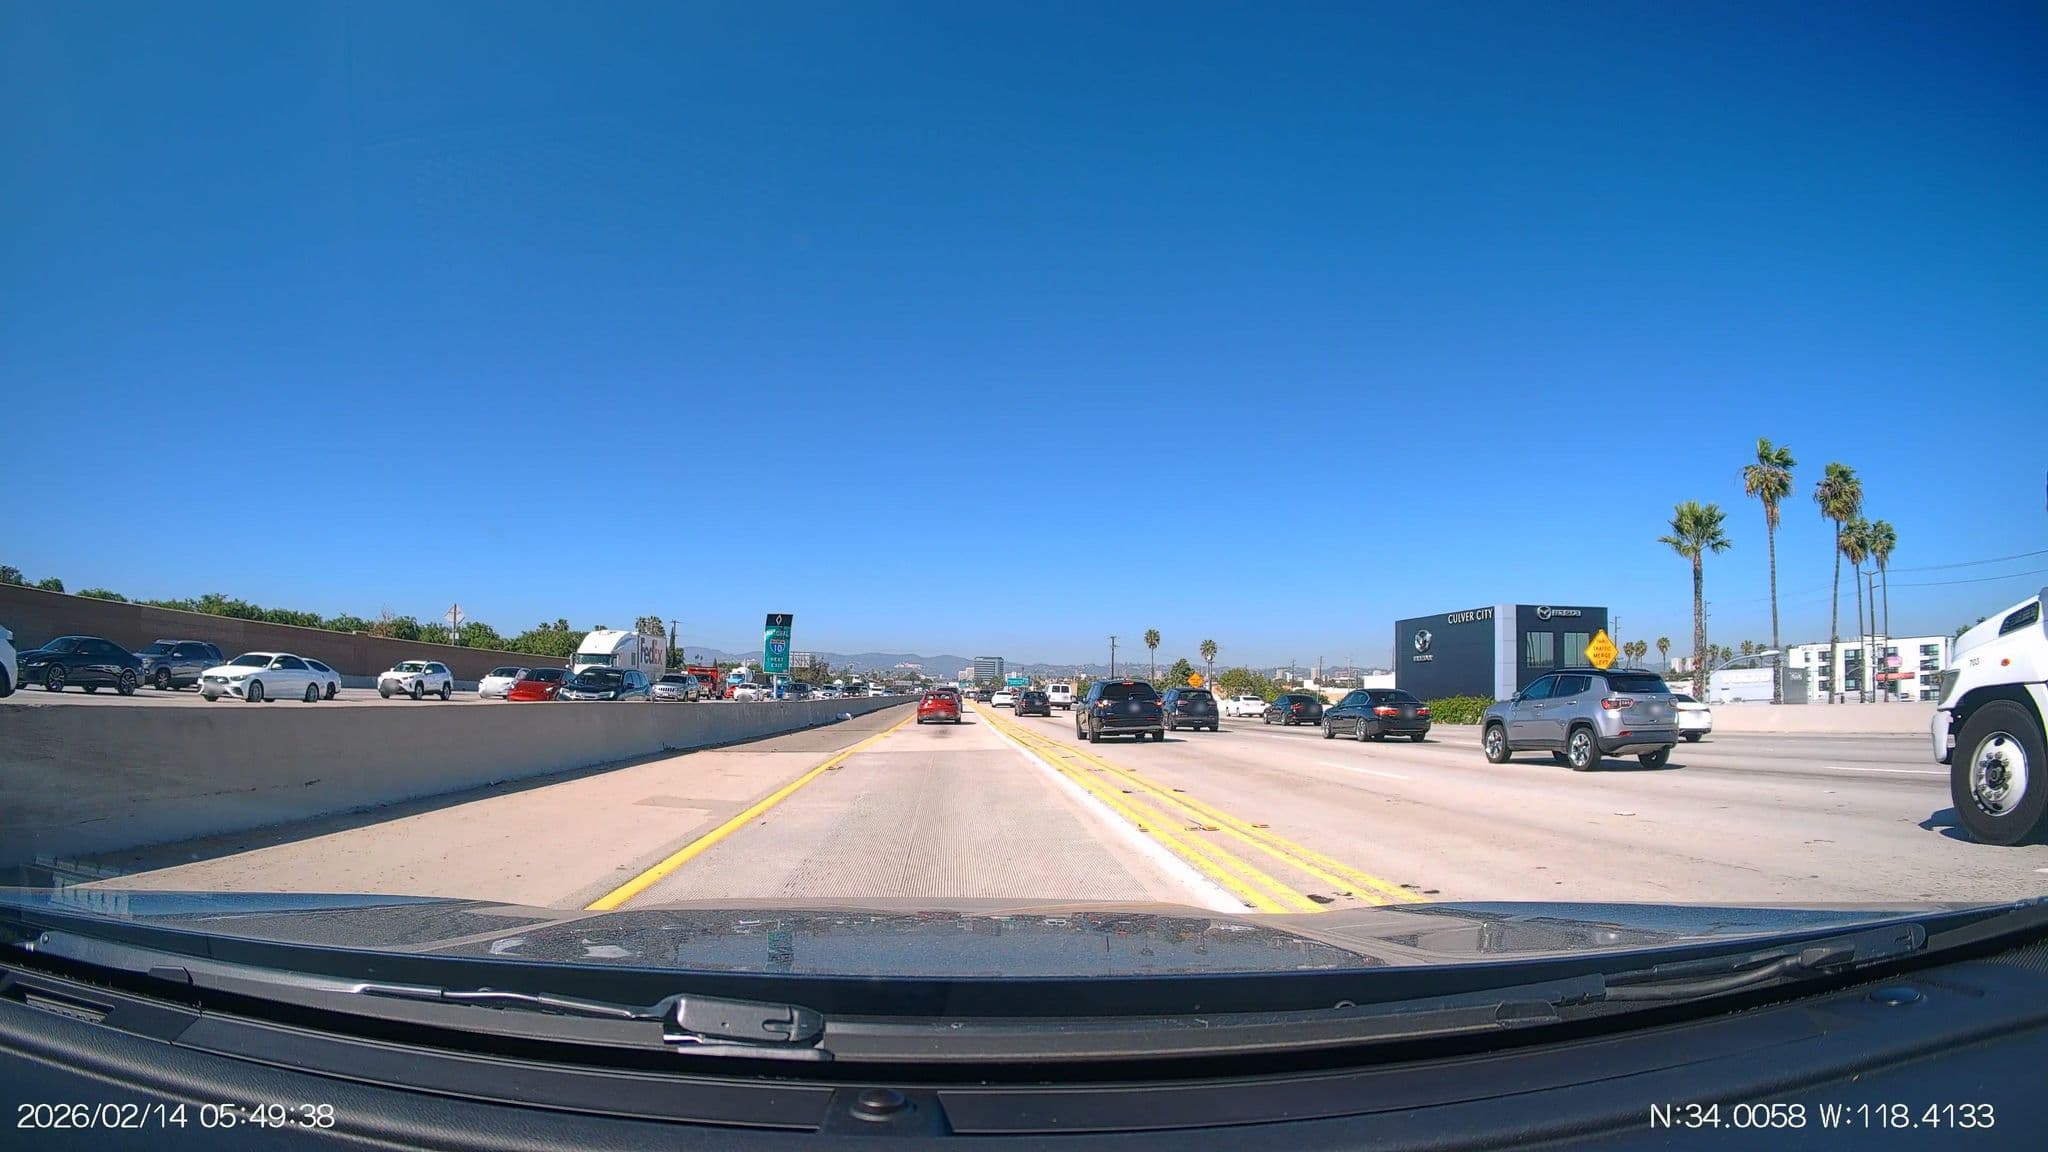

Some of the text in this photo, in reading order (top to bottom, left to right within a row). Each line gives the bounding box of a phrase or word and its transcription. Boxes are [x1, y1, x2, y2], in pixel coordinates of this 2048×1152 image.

[1447, 608, 1493, 624] CULVER CITY
[640, 637, 663, 666] FedEx
